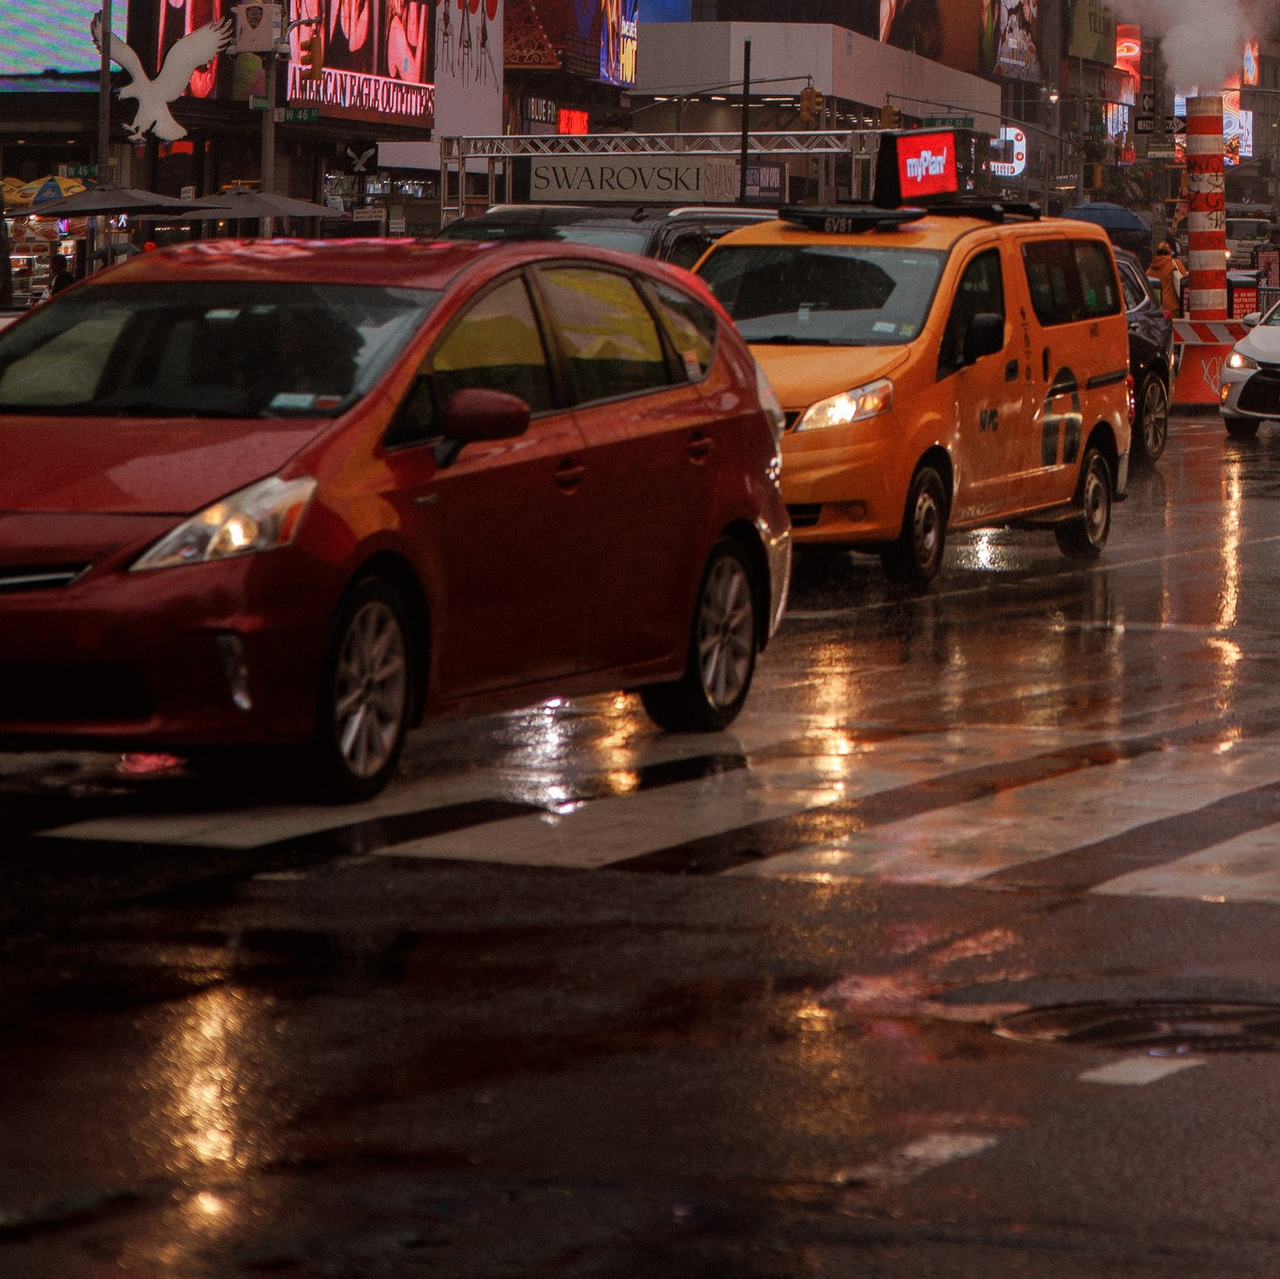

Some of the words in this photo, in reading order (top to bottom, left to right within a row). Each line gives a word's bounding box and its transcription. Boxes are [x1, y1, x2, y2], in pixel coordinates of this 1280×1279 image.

[620, 38, 636, 84] HOT
[297, 108, 308, 120] 46
[1141, 122, 1154, 130] ON
[534, 165, 700, 192] SWAROVSKI
[825, 218, 852, 232] 6V81
